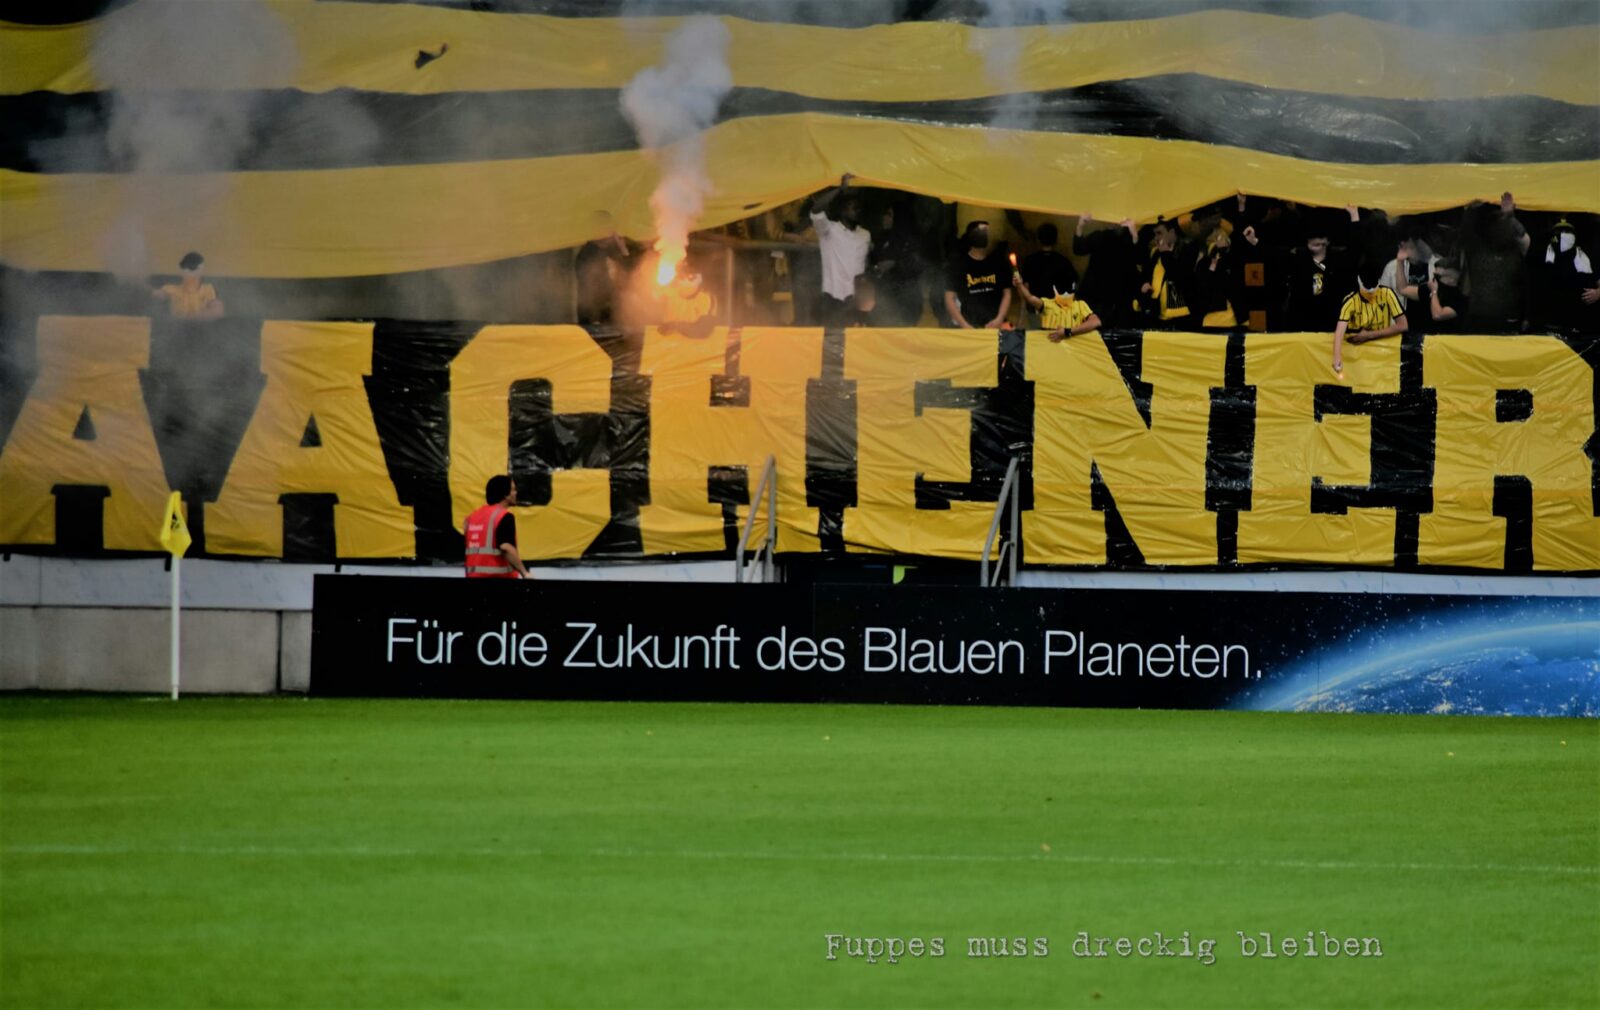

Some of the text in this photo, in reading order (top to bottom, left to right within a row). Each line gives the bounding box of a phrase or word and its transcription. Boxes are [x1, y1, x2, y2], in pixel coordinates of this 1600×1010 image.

[0, 314, 1600, 572] AACHENER
[387, 618, 1262, 678] Für die Zukunft des Blauen Planeten.
